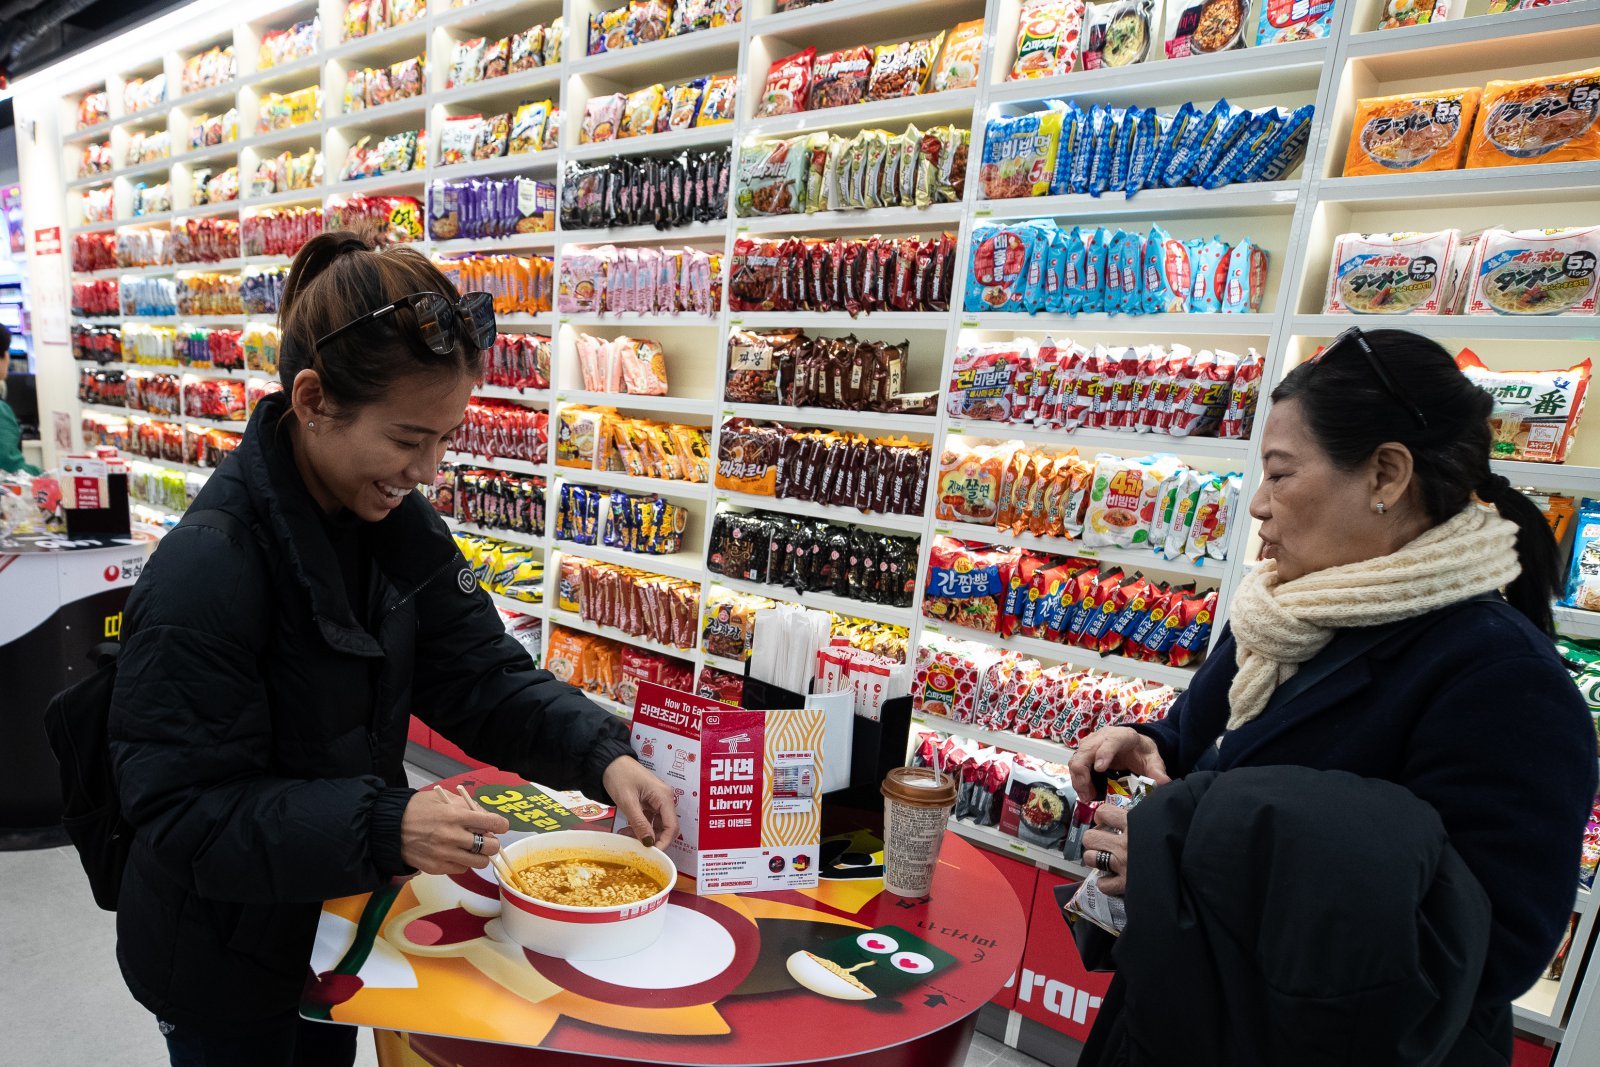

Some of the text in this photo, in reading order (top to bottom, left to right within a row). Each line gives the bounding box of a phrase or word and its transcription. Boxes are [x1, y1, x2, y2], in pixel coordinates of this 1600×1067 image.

[1002, 135, 1051, 159] 비빔면
[1364, 253, 1410, 267] サッポロ
[1512, 247, 1565, 264] サッポロ
[1566, 255, 1595, 270] 5食
[1411, 260, 1437, 274] 5食
[1349, 270, 1410, 293] タンメン
[1494, 266, 1565, 292] タンメン
[1484, 385, 1533, 399] ッポロ
[1500, 389, 1566, 415] 一番
[718, 460, 768, 478] 짜짜로니
[938, 570, 990, 596] 간짬뽕
[926, 689, 953, 702] 스파게티
[665, 697, 680, 709] How
[682, 702, 691, 713] To
[640, 703, 690, 728] 라면조리기
[710, 759, 753, 782] 라면
[709, 784, 753, 796] RAMYUN
[709, 798, 752, 812] Library
[709, 817, 752, 829] 인증 이벤트
[917, 920, 998, 948] 나 다시마
